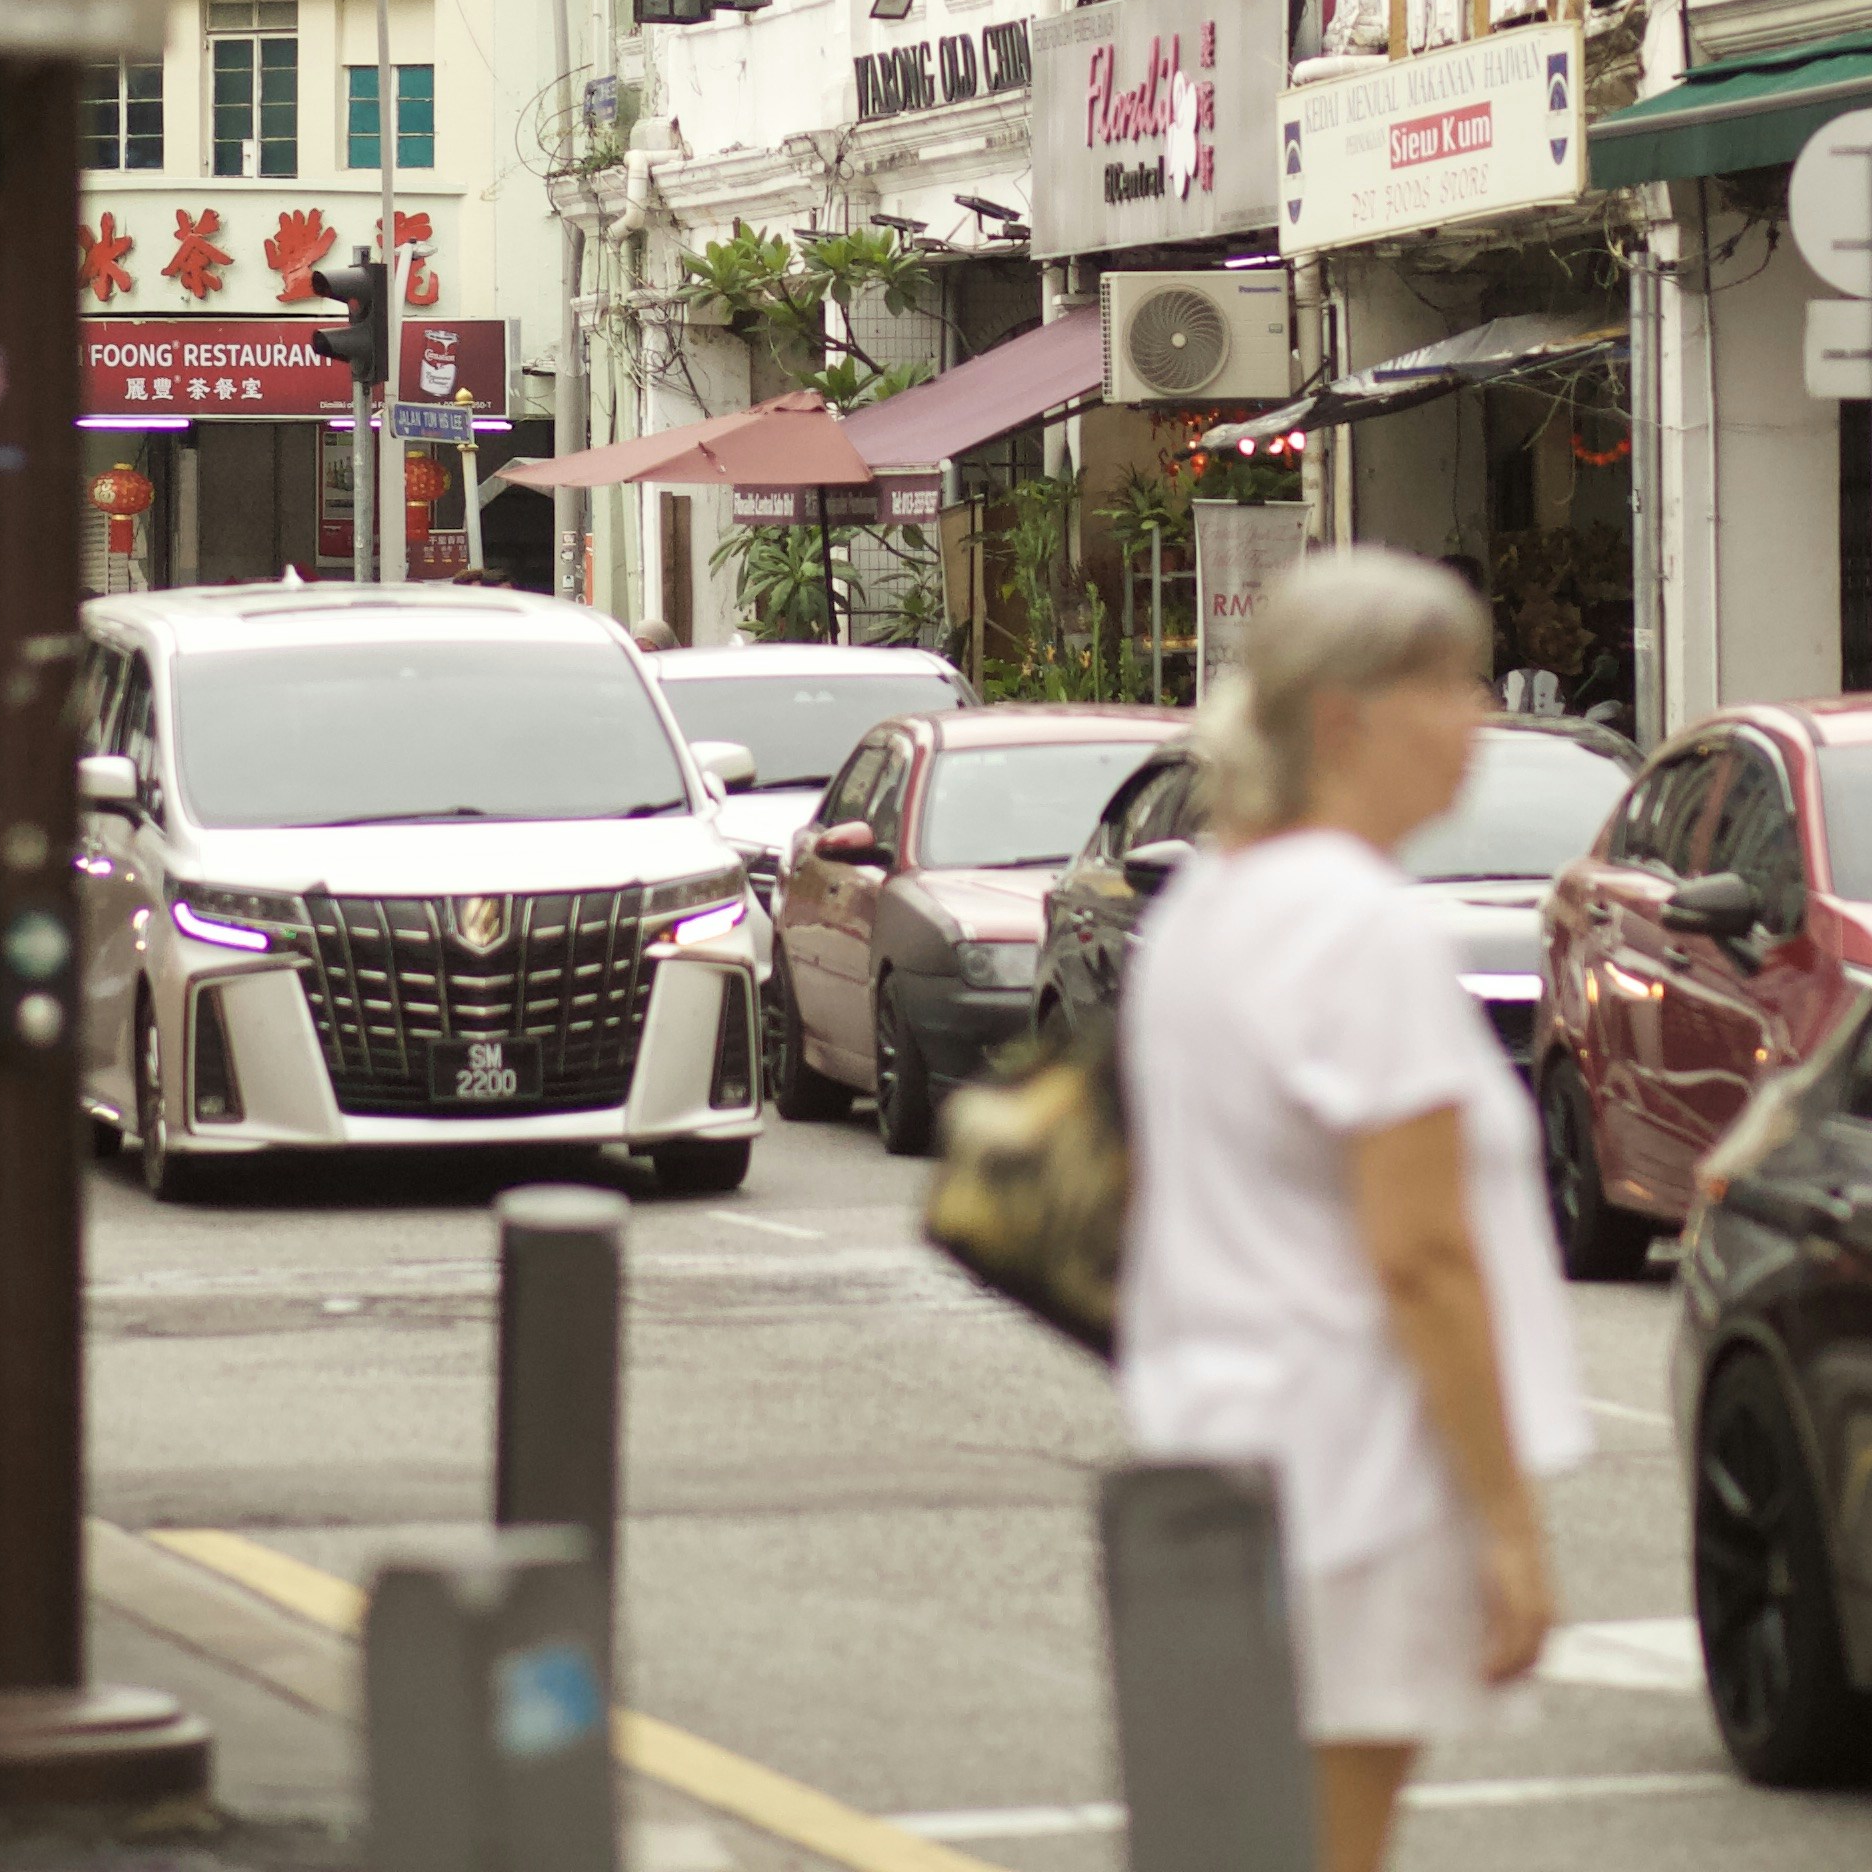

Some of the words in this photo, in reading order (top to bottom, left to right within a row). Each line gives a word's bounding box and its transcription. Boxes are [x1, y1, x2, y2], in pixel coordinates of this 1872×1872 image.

[853, 40, 935, 120] WARONG
[939, 33, 978, 103] OLD
[1305, 95, 1339, 135] KEDAI
[1346, 77, 1400, 124] MENJUAL
[1406, 56, 1476, 108] MAKANAN
[1483, 39, 1542, 89] HAIWAN
[1390, 127, 1438, 164] Siew
[1441, 115, 1492, 152] Kum
[398, 409, 421, 426] JALAN
[468, 1043, 503, 1069] SM
[456, 1069, 517, 1098] 2200
